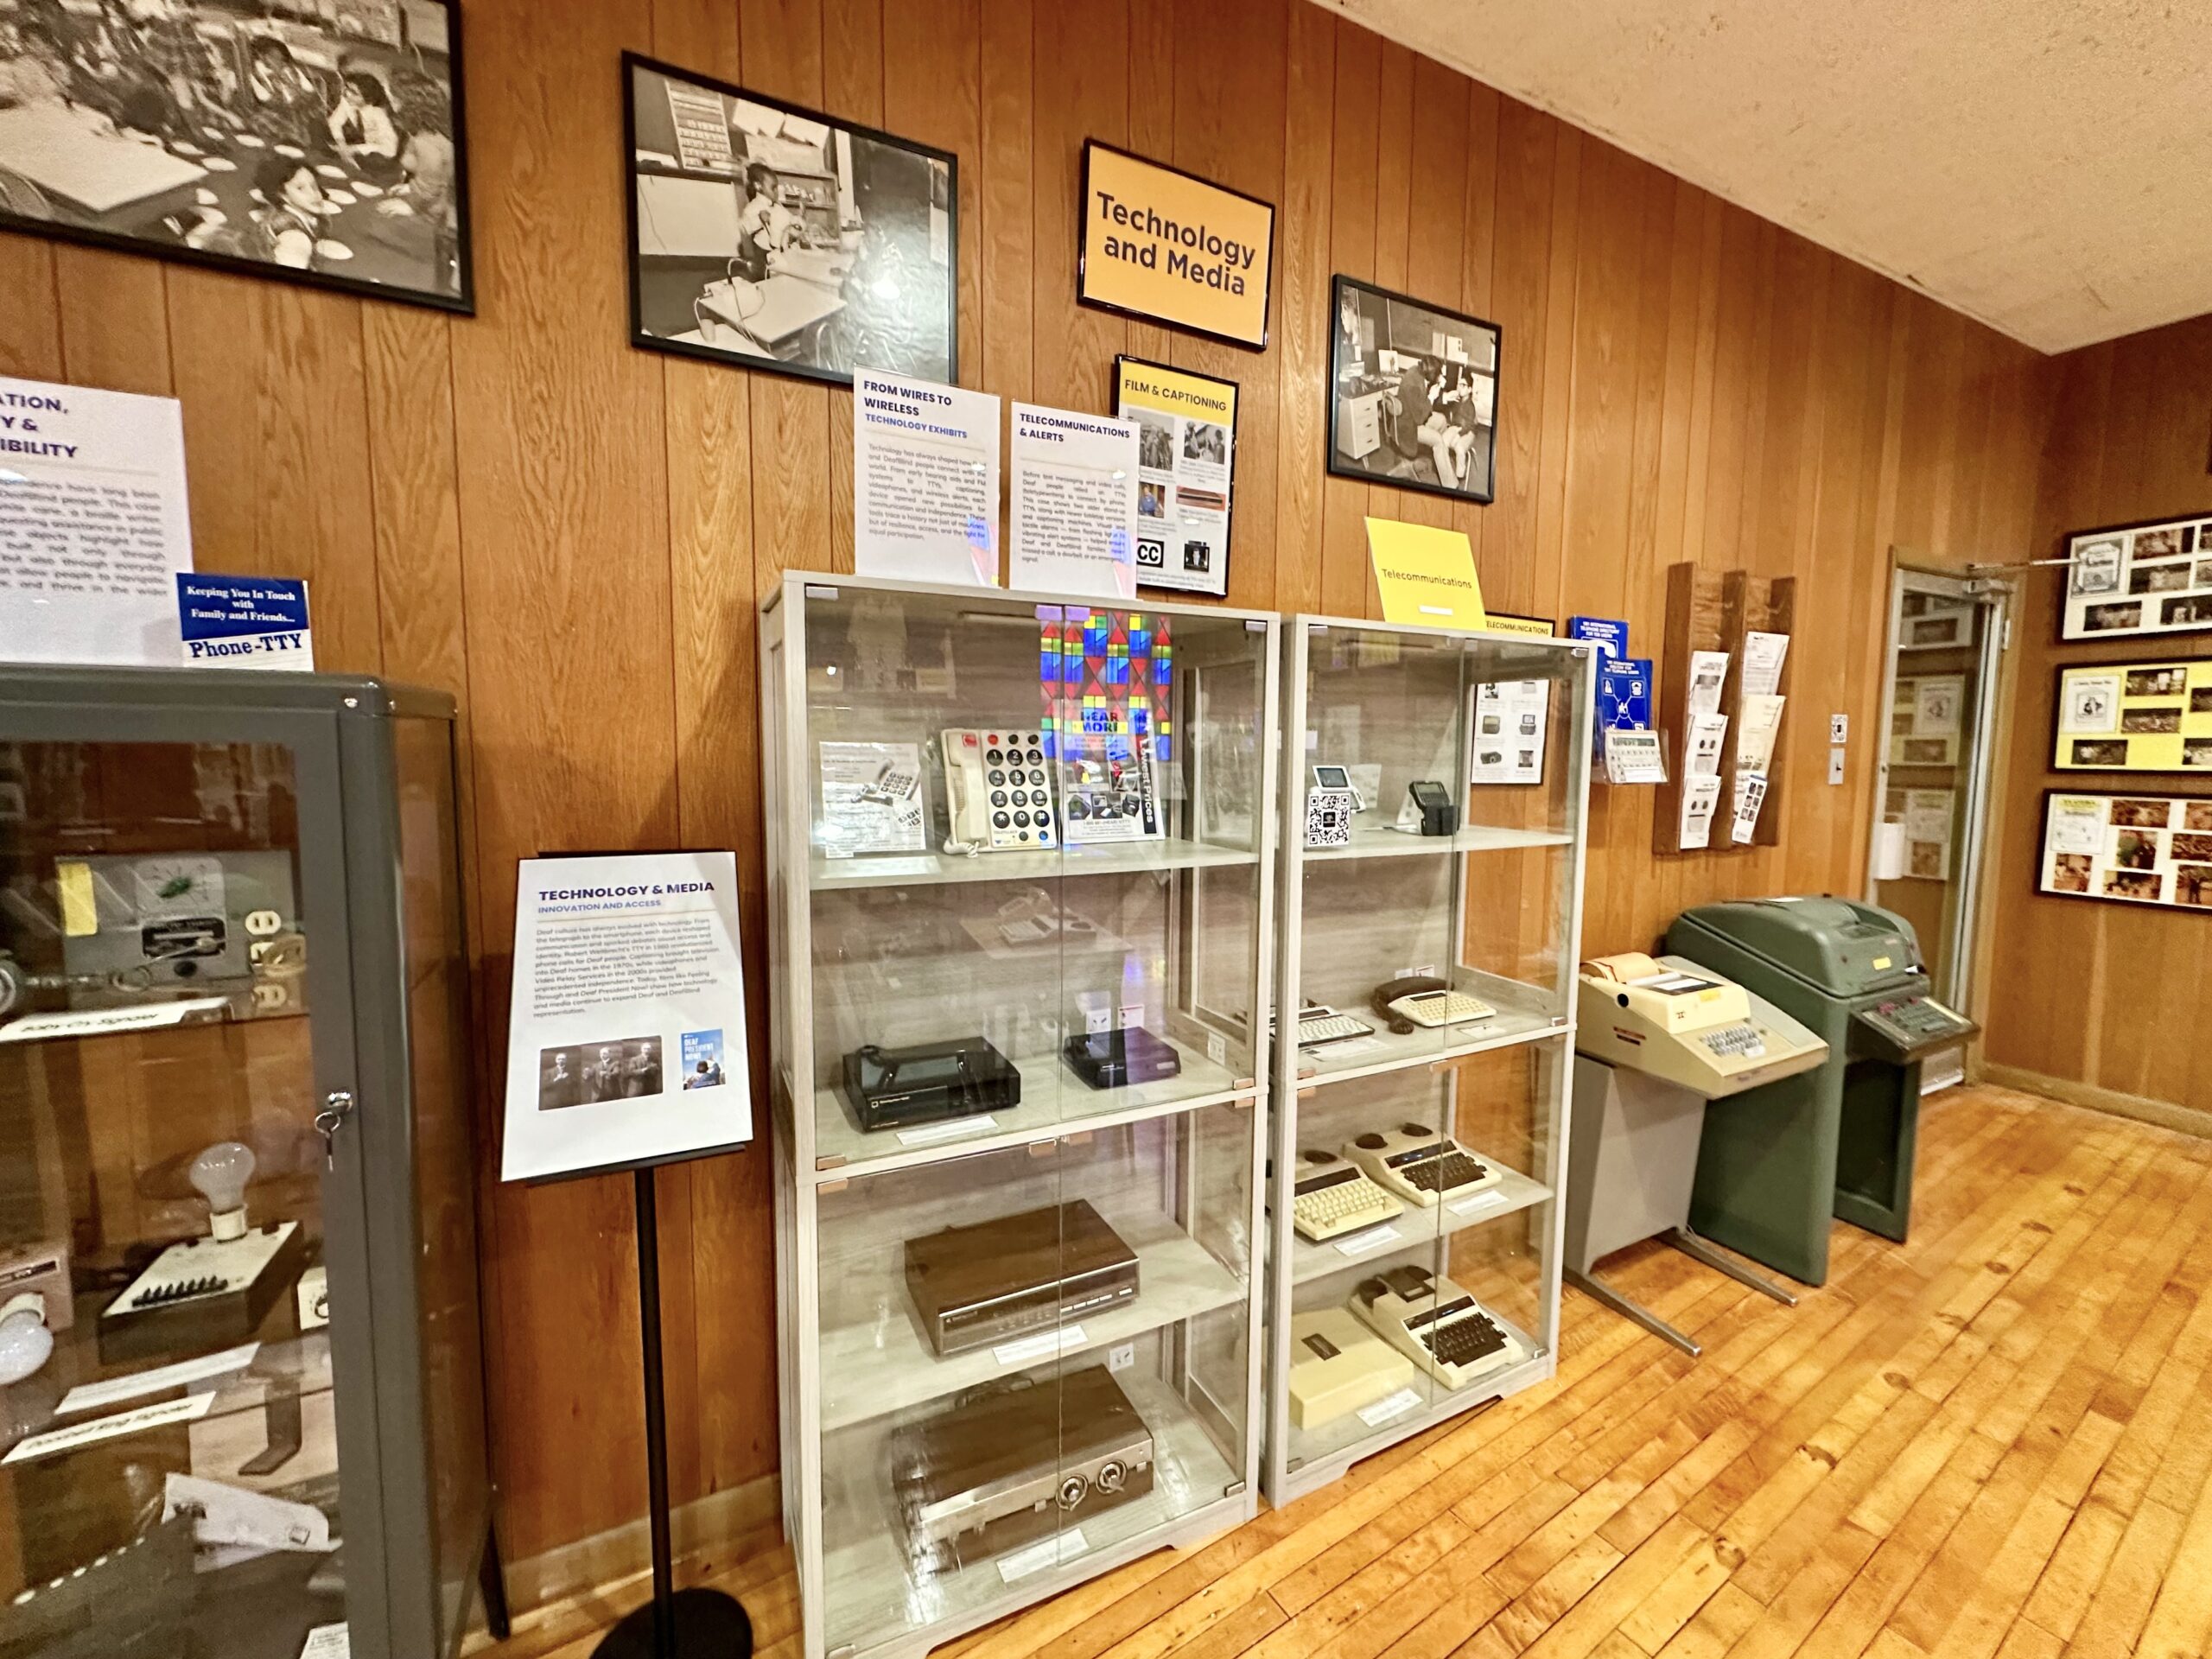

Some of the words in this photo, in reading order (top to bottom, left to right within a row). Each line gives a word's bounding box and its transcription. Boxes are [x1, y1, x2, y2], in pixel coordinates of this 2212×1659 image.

[1096, 191, 1255, 270] Technology
[1104, 235, 1157, 270] and
[1167, 250, 1245, 296] Media
[864, 380, 898, 396] FROM
[900, 387, 935, 403] WIRES
[938, 395, 952, 406] TO
[1125, 379, 1149, 394] FILM
[1152, 385, 1160, 396] &
[1162, 388, 1226, 411] CAPTIONING
[864, 397, 919, 416] WIRELESS
[866, 413, 927, 431] TECHNOLOGY
[929, 424, 968, 439] EXHIBITS
[1020, 413, 1130, 439] TELECOMMUNICATIONS
[1020, 428, 1027, 437] &
[1029, 430, 1064, 442] ALERTS
[868, 443, 902, 455] Technology
[916, 451, 935, 461] always
[938, 455, 957, 466] shaped
[868, 472, 893, 482] systems
[907, 468, 922, 477] early
[925, 471, 947, 481] hearing
[915, 461, 934, 470] people
[937, 464, 959, 474] connect
[868, 490, 887, 499] device
[894, 494, 916, 504] opened
[940, 500, 971, 512] possibilities
[925, 489, 948, 498] wireless
[868, 499, 913, 512] communication
[907, 514, 927, 523] history
[868, 528, 886, 537] equal
[1138, 544, 1159, 563] CC
[1382, 568, 1472, 589] Telecommunications
[187, 586, 228, 599] Keeping
[230, 588, 250, 598] You
[252, 590, 264, 599] In
[265, 590, 296, 601] Touch
[232, 600, 254, 609] with
[191, 608, 226, 621] Family
[229, 612, 248, 620] and
[250, 611, 296, 622] Friends...
[189, 633, 302, 658] Phone-TTY
[1140, 738, 1152, 783] Lowest
[1143, 785, 1154, 823] Prices
[539, 886, 649, 901] TECHNOLOGY
[652, 885, 664, 894] &
[667, 882, 715, 894] MEDIA
[538, 904, 601, 914] INNOVATION
[602, 901, 623, 910] AND
[625, 899, 661, 908] ACCESS
